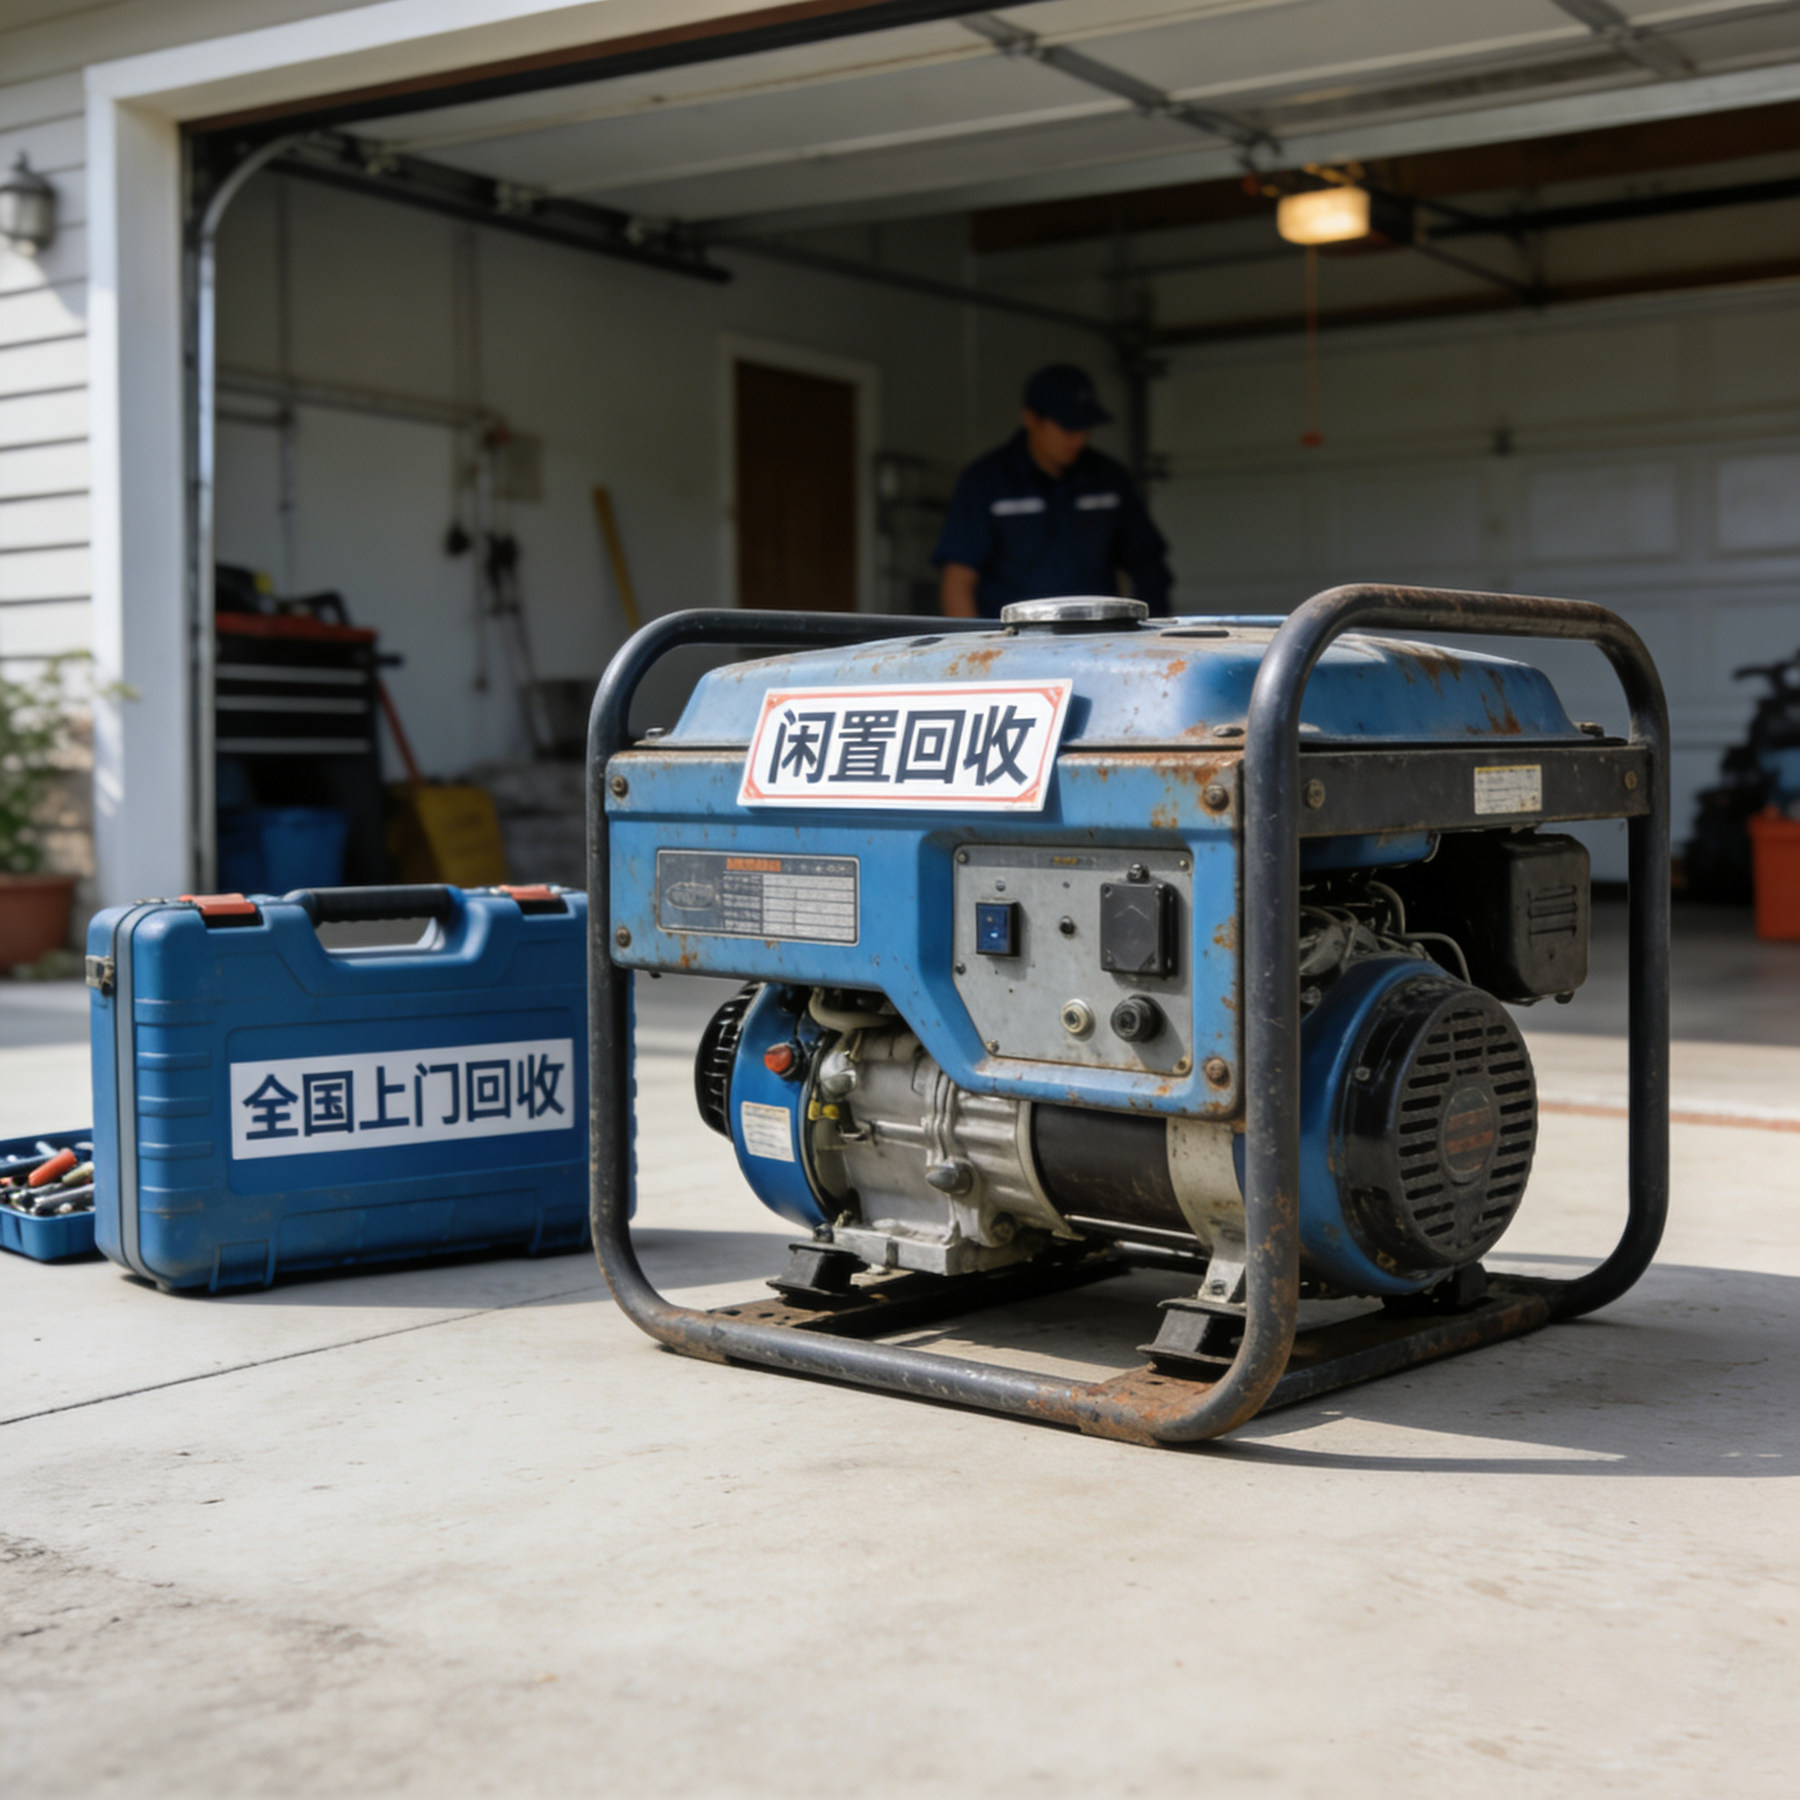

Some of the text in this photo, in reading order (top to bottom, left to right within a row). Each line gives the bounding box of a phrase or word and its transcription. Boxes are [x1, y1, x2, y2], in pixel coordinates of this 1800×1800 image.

[768, 705, 1037, 786] 闲置回收
[242, 1053, 565, 1140] 全国上门回收
